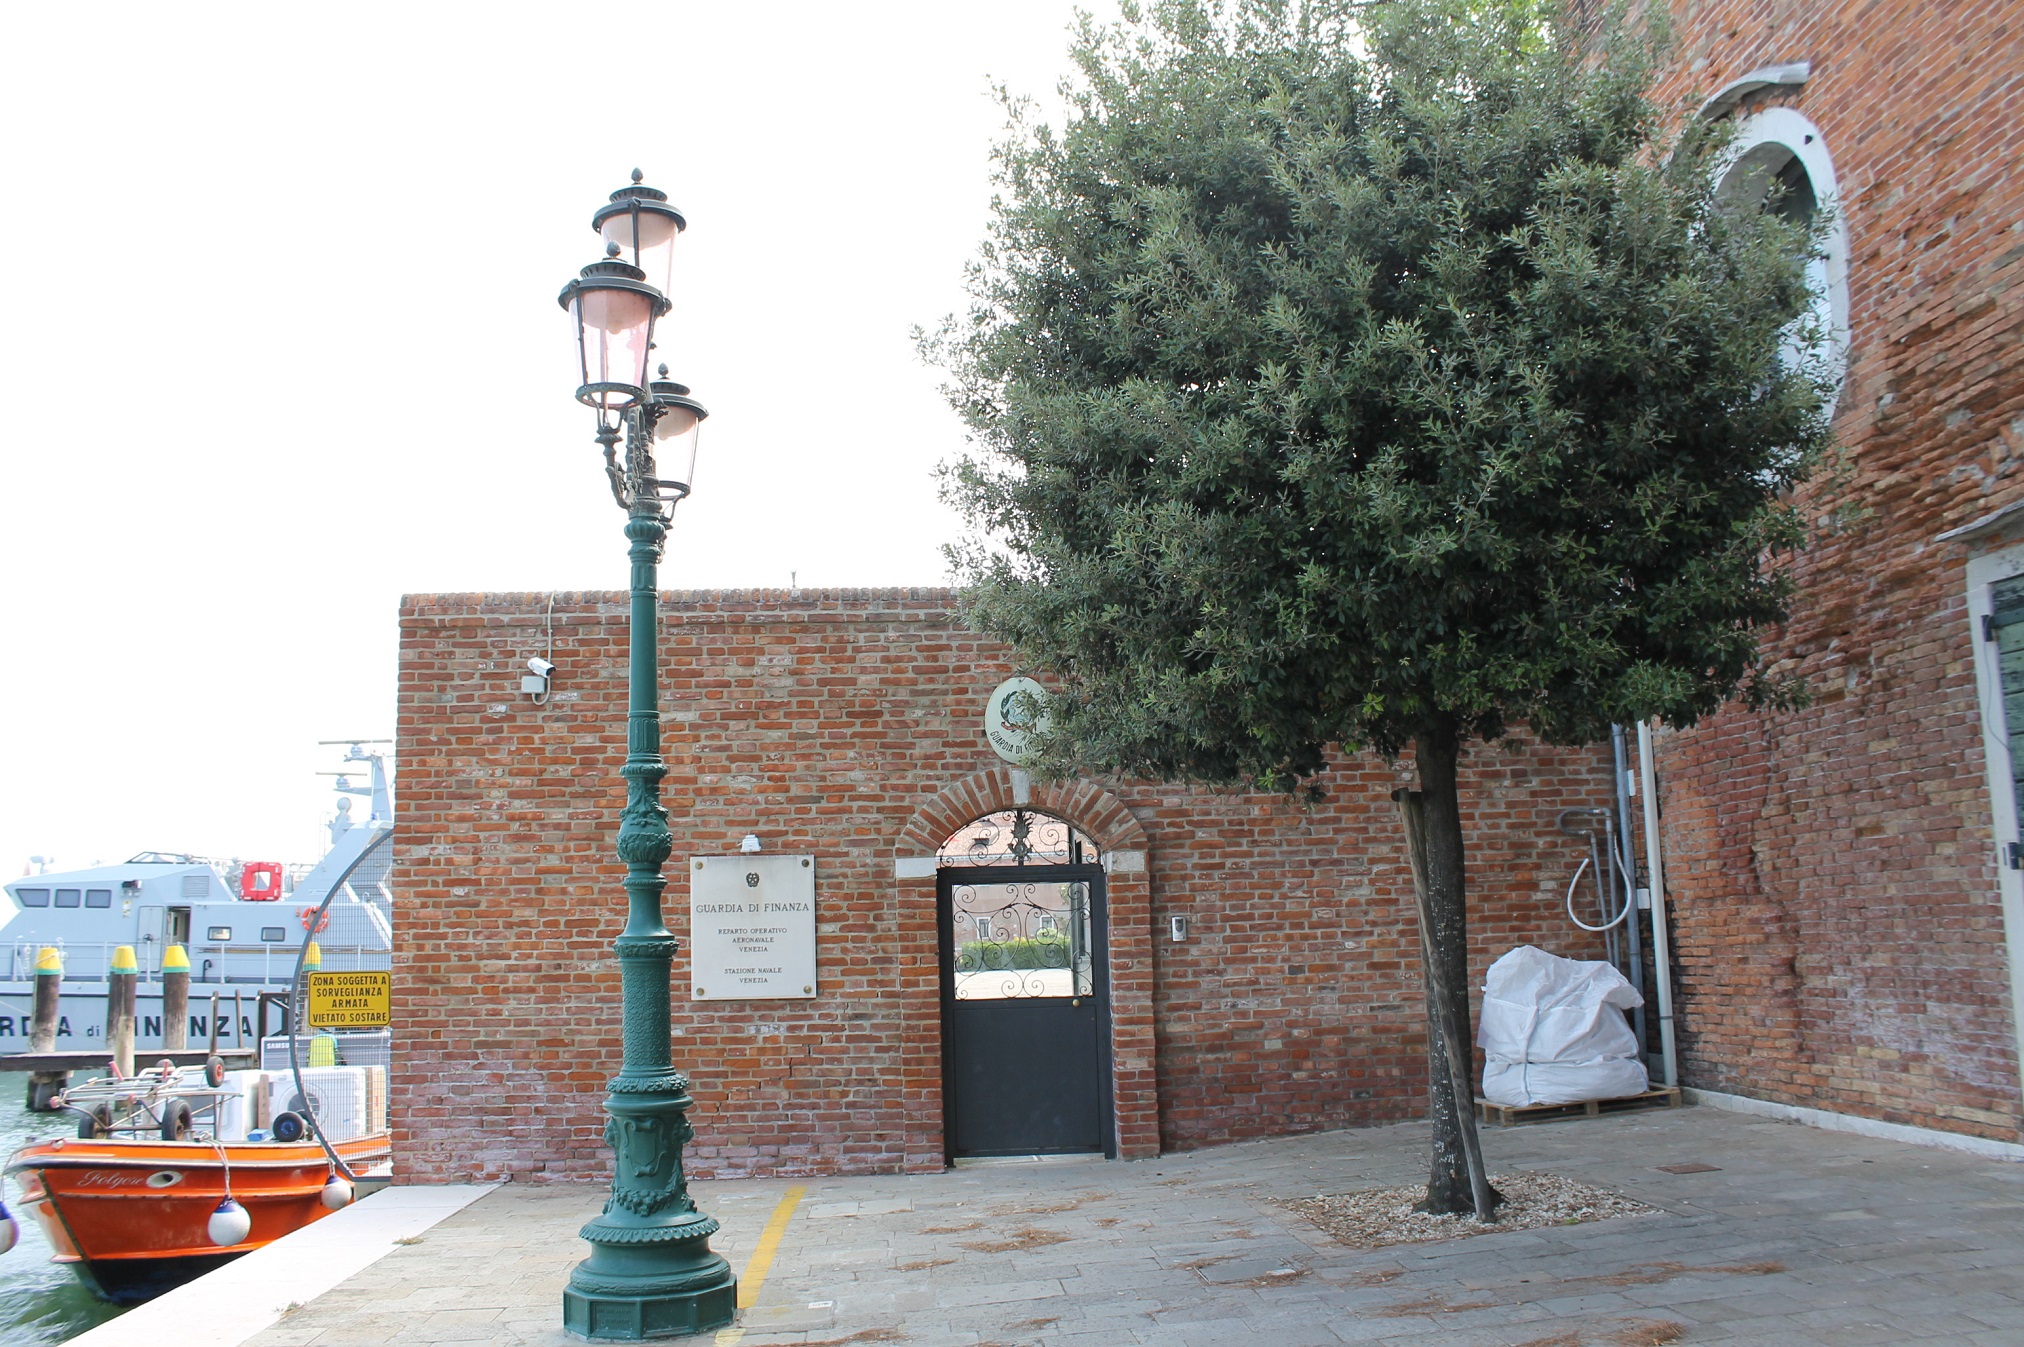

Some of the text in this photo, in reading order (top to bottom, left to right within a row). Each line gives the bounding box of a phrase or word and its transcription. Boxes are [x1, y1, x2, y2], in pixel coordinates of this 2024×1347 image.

[990, 731, 1013, 753] GUARDIA
[1015, 745, 1023, 754] DI
[696, 903, 809, 913] GUARDIA DI FINANZA
[313, 976, 386, 986] ZONA SOGGETTA A
[317, 988, 382, 997] SORVEGLIANZA
[332, 999, 369, 1008] ARMATA
[313, 1013, 387, 1022] VIETATO SOSTARE
[87, 1026, 100, 1036] di
